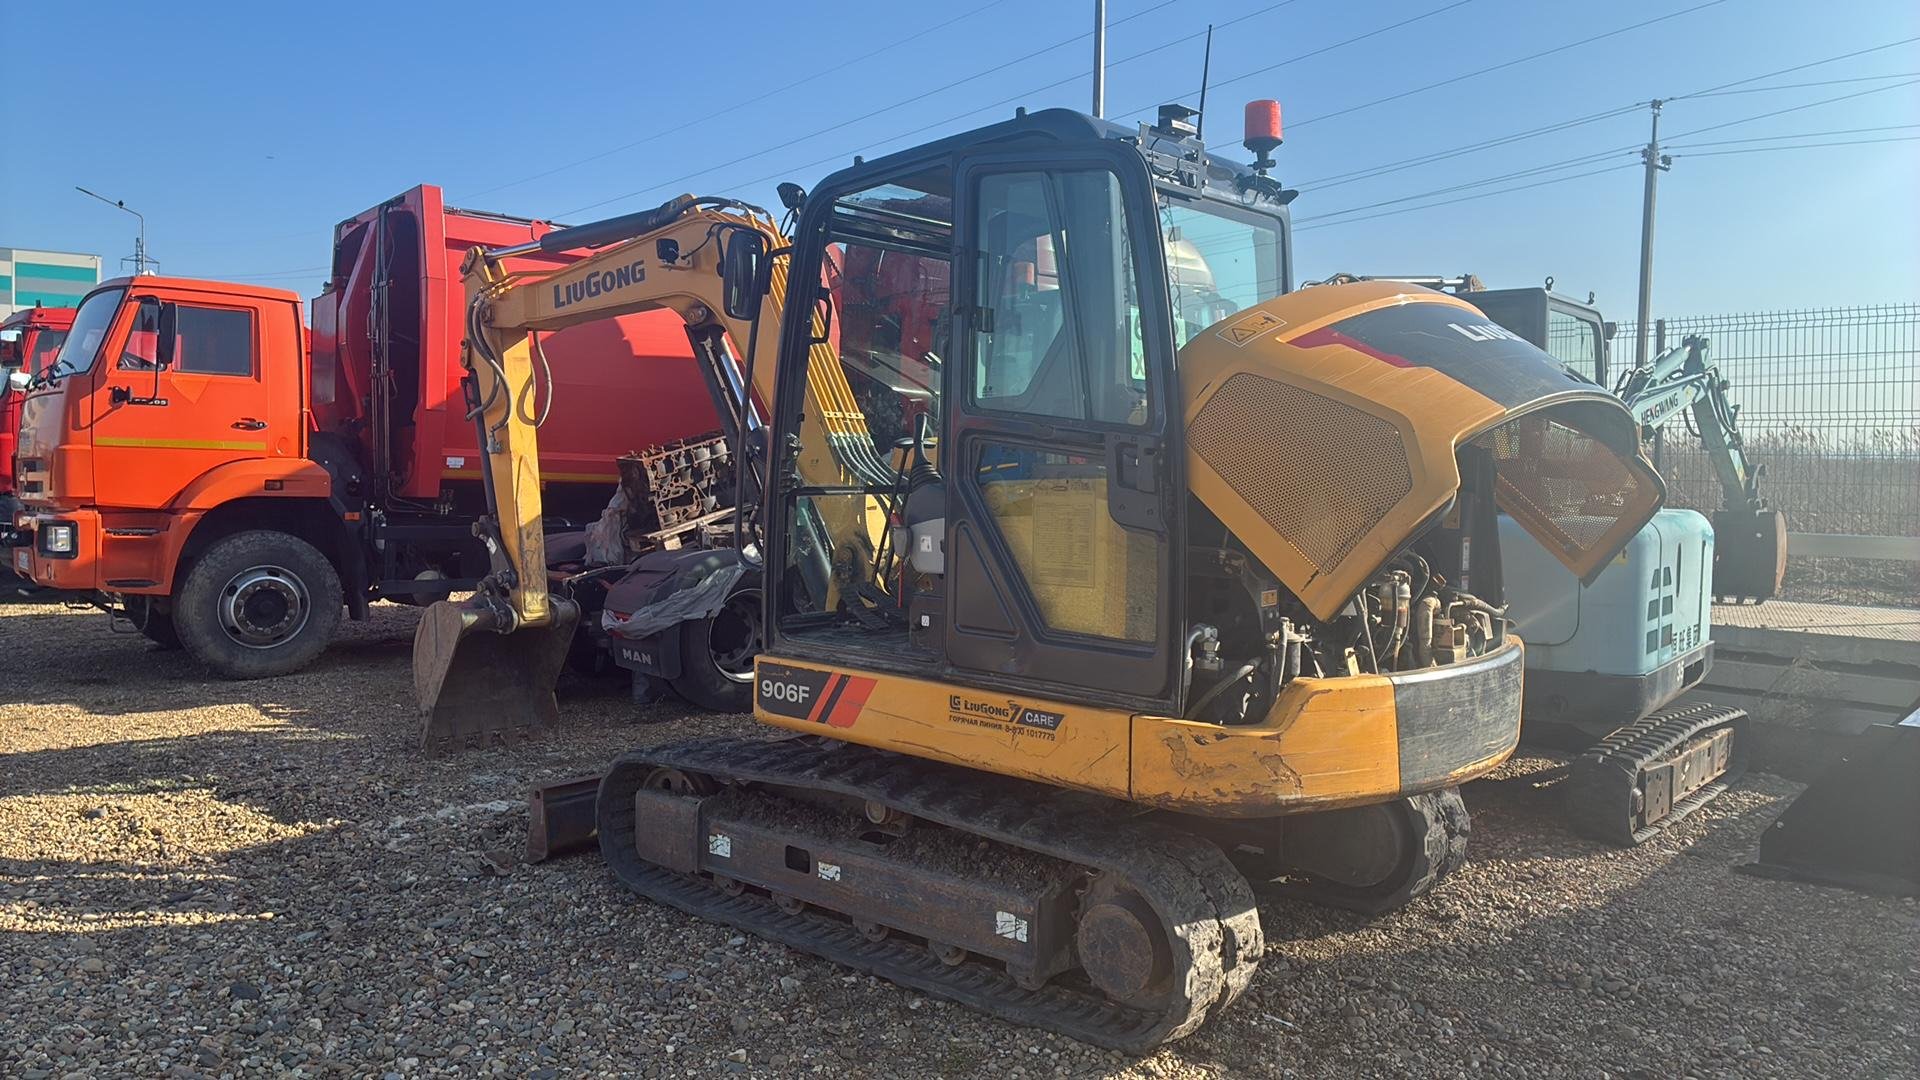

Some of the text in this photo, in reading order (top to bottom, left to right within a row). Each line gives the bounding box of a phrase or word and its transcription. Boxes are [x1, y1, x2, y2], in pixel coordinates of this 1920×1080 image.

[1641, 392, 1679, 425] HENGWANG
[622, 647, 652, 665] MAN
[761, 679, 810, 704] 906F
[1025, 711, 1055, 727] CARE
[1026, 730, 1056, 741] 1017779
